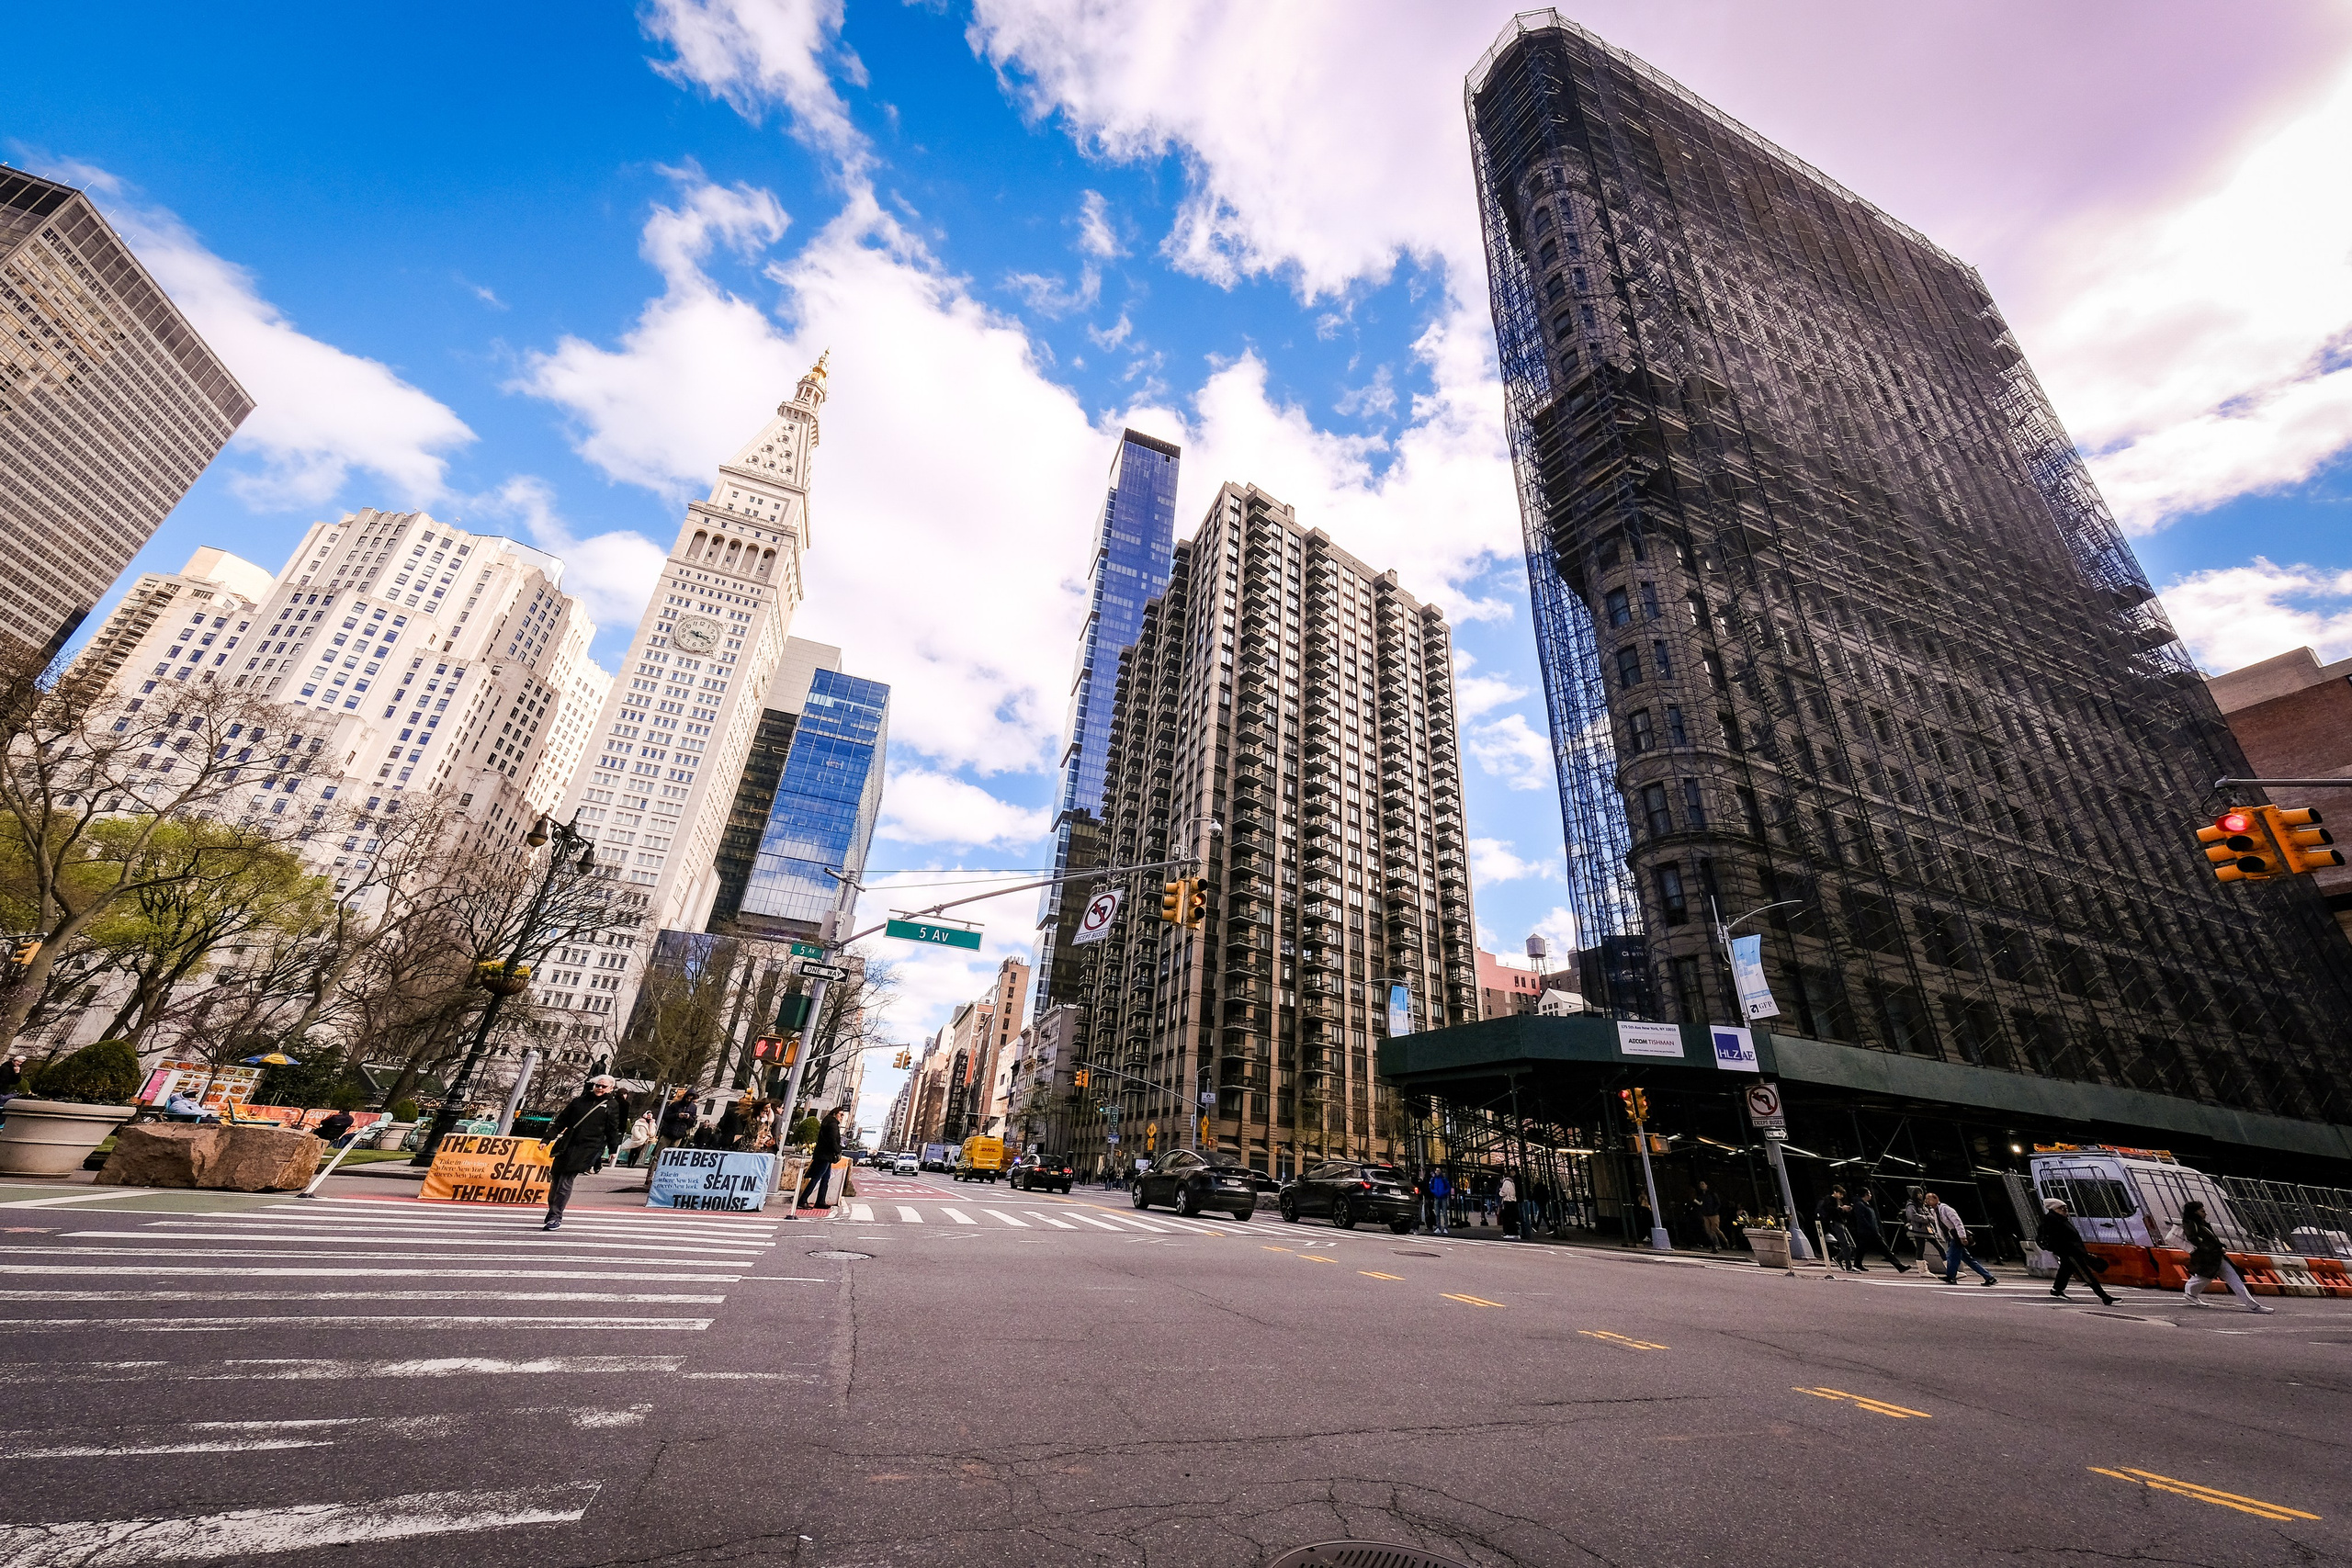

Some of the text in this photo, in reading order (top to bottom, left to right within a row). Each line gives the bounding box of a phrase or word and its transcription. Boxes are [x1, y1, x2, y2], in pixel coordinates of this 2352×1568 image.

[919, 927, 927, 939] 5
[1074, 933, 1091, 942] EXCEPT
[800, 946, 806, 955] 5
[807, 966, 822, 974] ONE
[1758, 1001, 1772, 1010] GFP
[308, 1111, 329, 1119] EASY
[442, 1135, 524, 1162] THE BEST
[662, 1151, 728, 1172] THE BEST
[491, 1162, 551, 1186] SEAT IN
[703, 1174, 741, 1194] SEAT
[741, 1176, 757, 1192] IN
[452, 1184, 545, 1203] THE HOUSE
[673, 1194, 749, 1211] THE HOUSE
